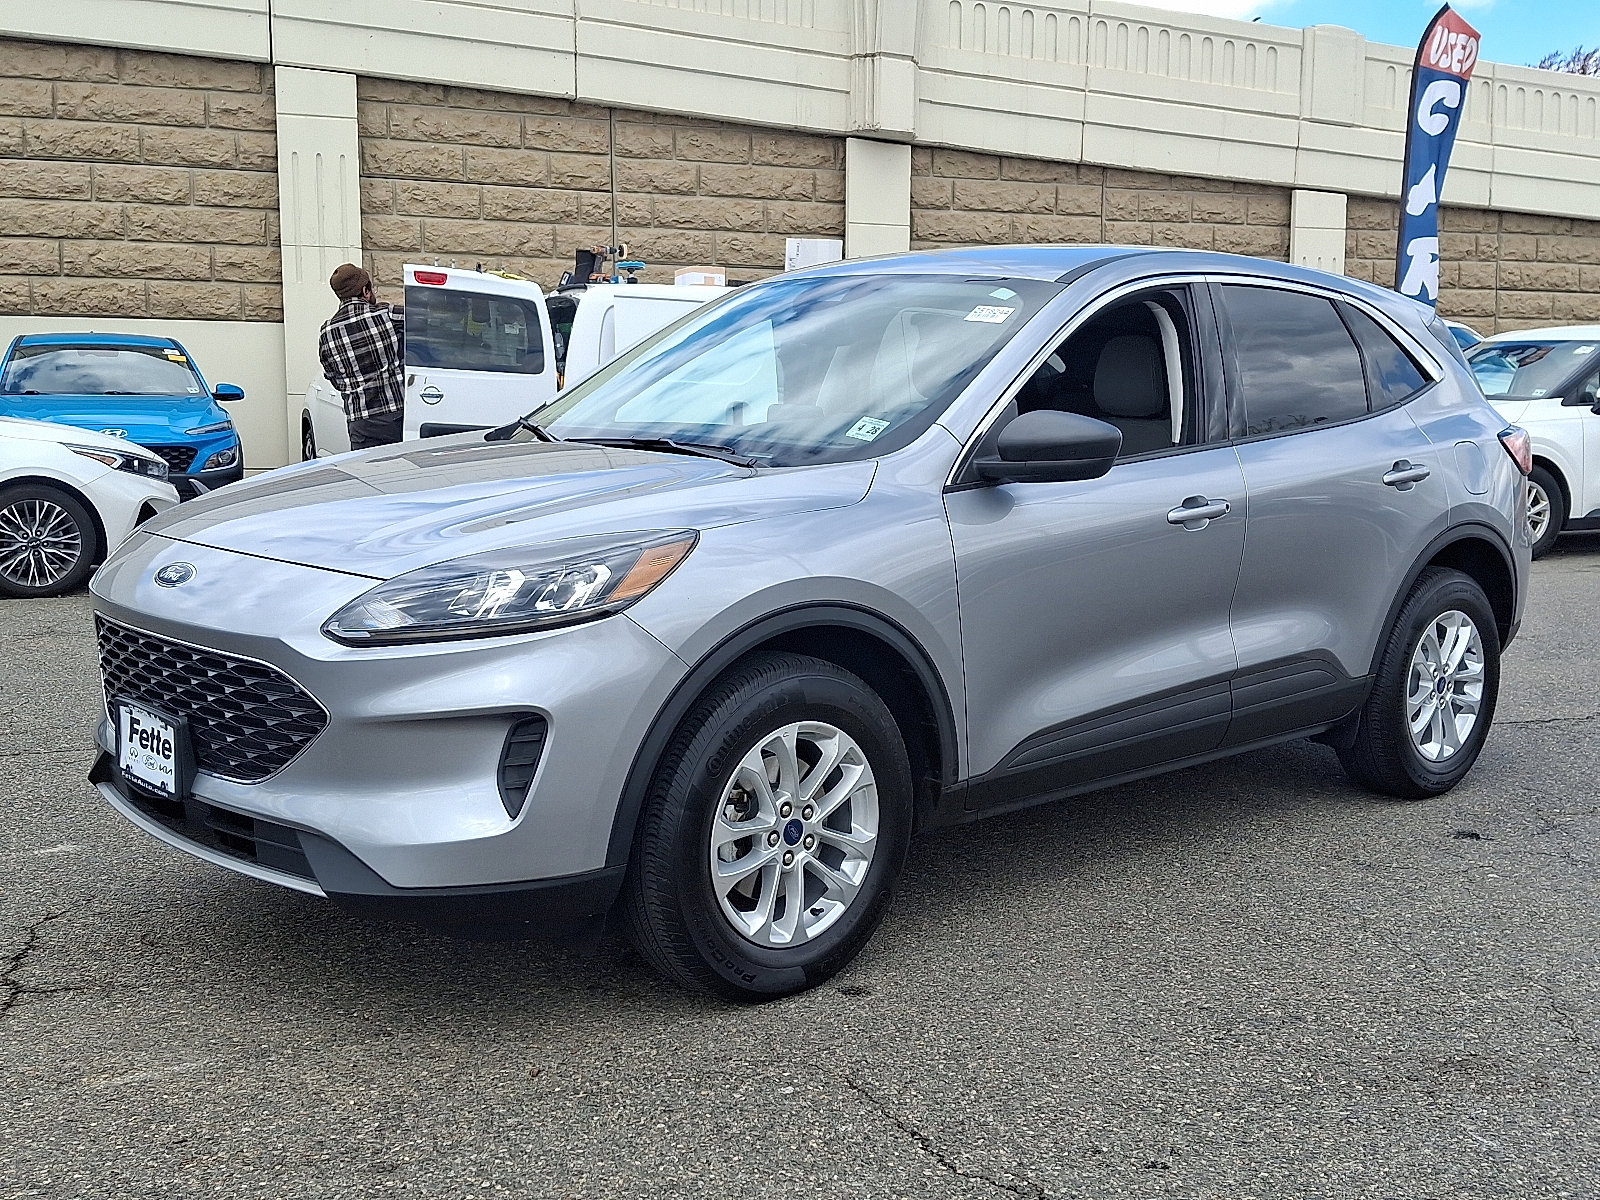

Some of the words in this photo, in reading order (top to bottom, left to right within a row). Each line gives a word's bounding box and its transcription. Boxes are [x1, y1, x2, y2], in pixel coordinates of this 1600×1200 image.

[1430, 25, 1478, 73] USED
[128, 716, 172, 760] Fette
[121, 770, 169, 798] FetteAuto.com
